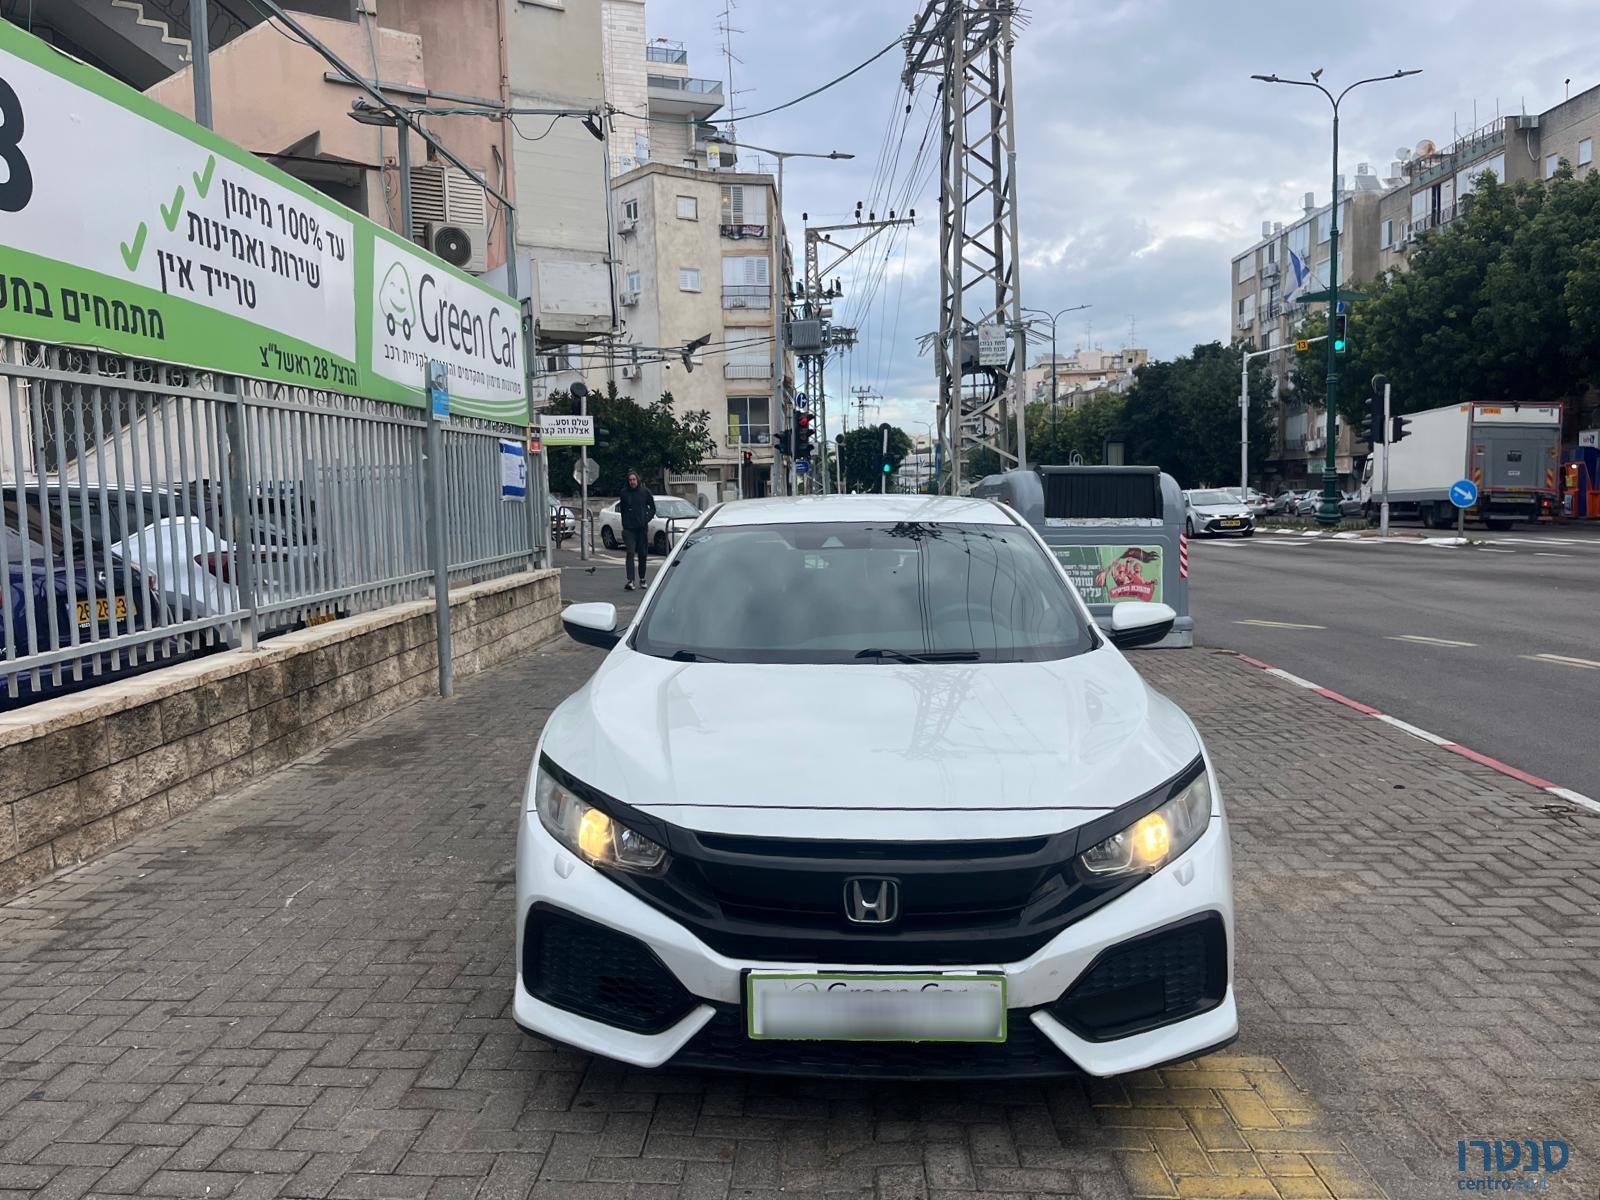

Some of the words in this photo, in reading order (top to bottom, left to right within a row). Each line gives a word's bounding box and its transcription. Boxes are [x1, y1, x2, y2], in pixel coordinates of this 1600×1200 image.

[221, 178, 273, 229] מימון
[187, 210, 266, 269] ואמינות
[278, 203, 323, 252] 100%
[325, 230, 345, 262] עד
[157, 249, 195, 294] אין
[200, 264, 257, 310] טרייד
[270, 245, 320, 289] שירות
[60, 287, 165, 341] מתמחים
[418, 273, 486, 360] Green
[488, 307, 517, 370] Car
[384, 344, 400, 362] רכב
[1298, 341, 1306, 349] 13
[313, 355, 328, 380] 28
[331, 358, 358, 387] הרצל
[568, 426, 590, 435] אצלנו
[571, 418, 589, 427] שלם
